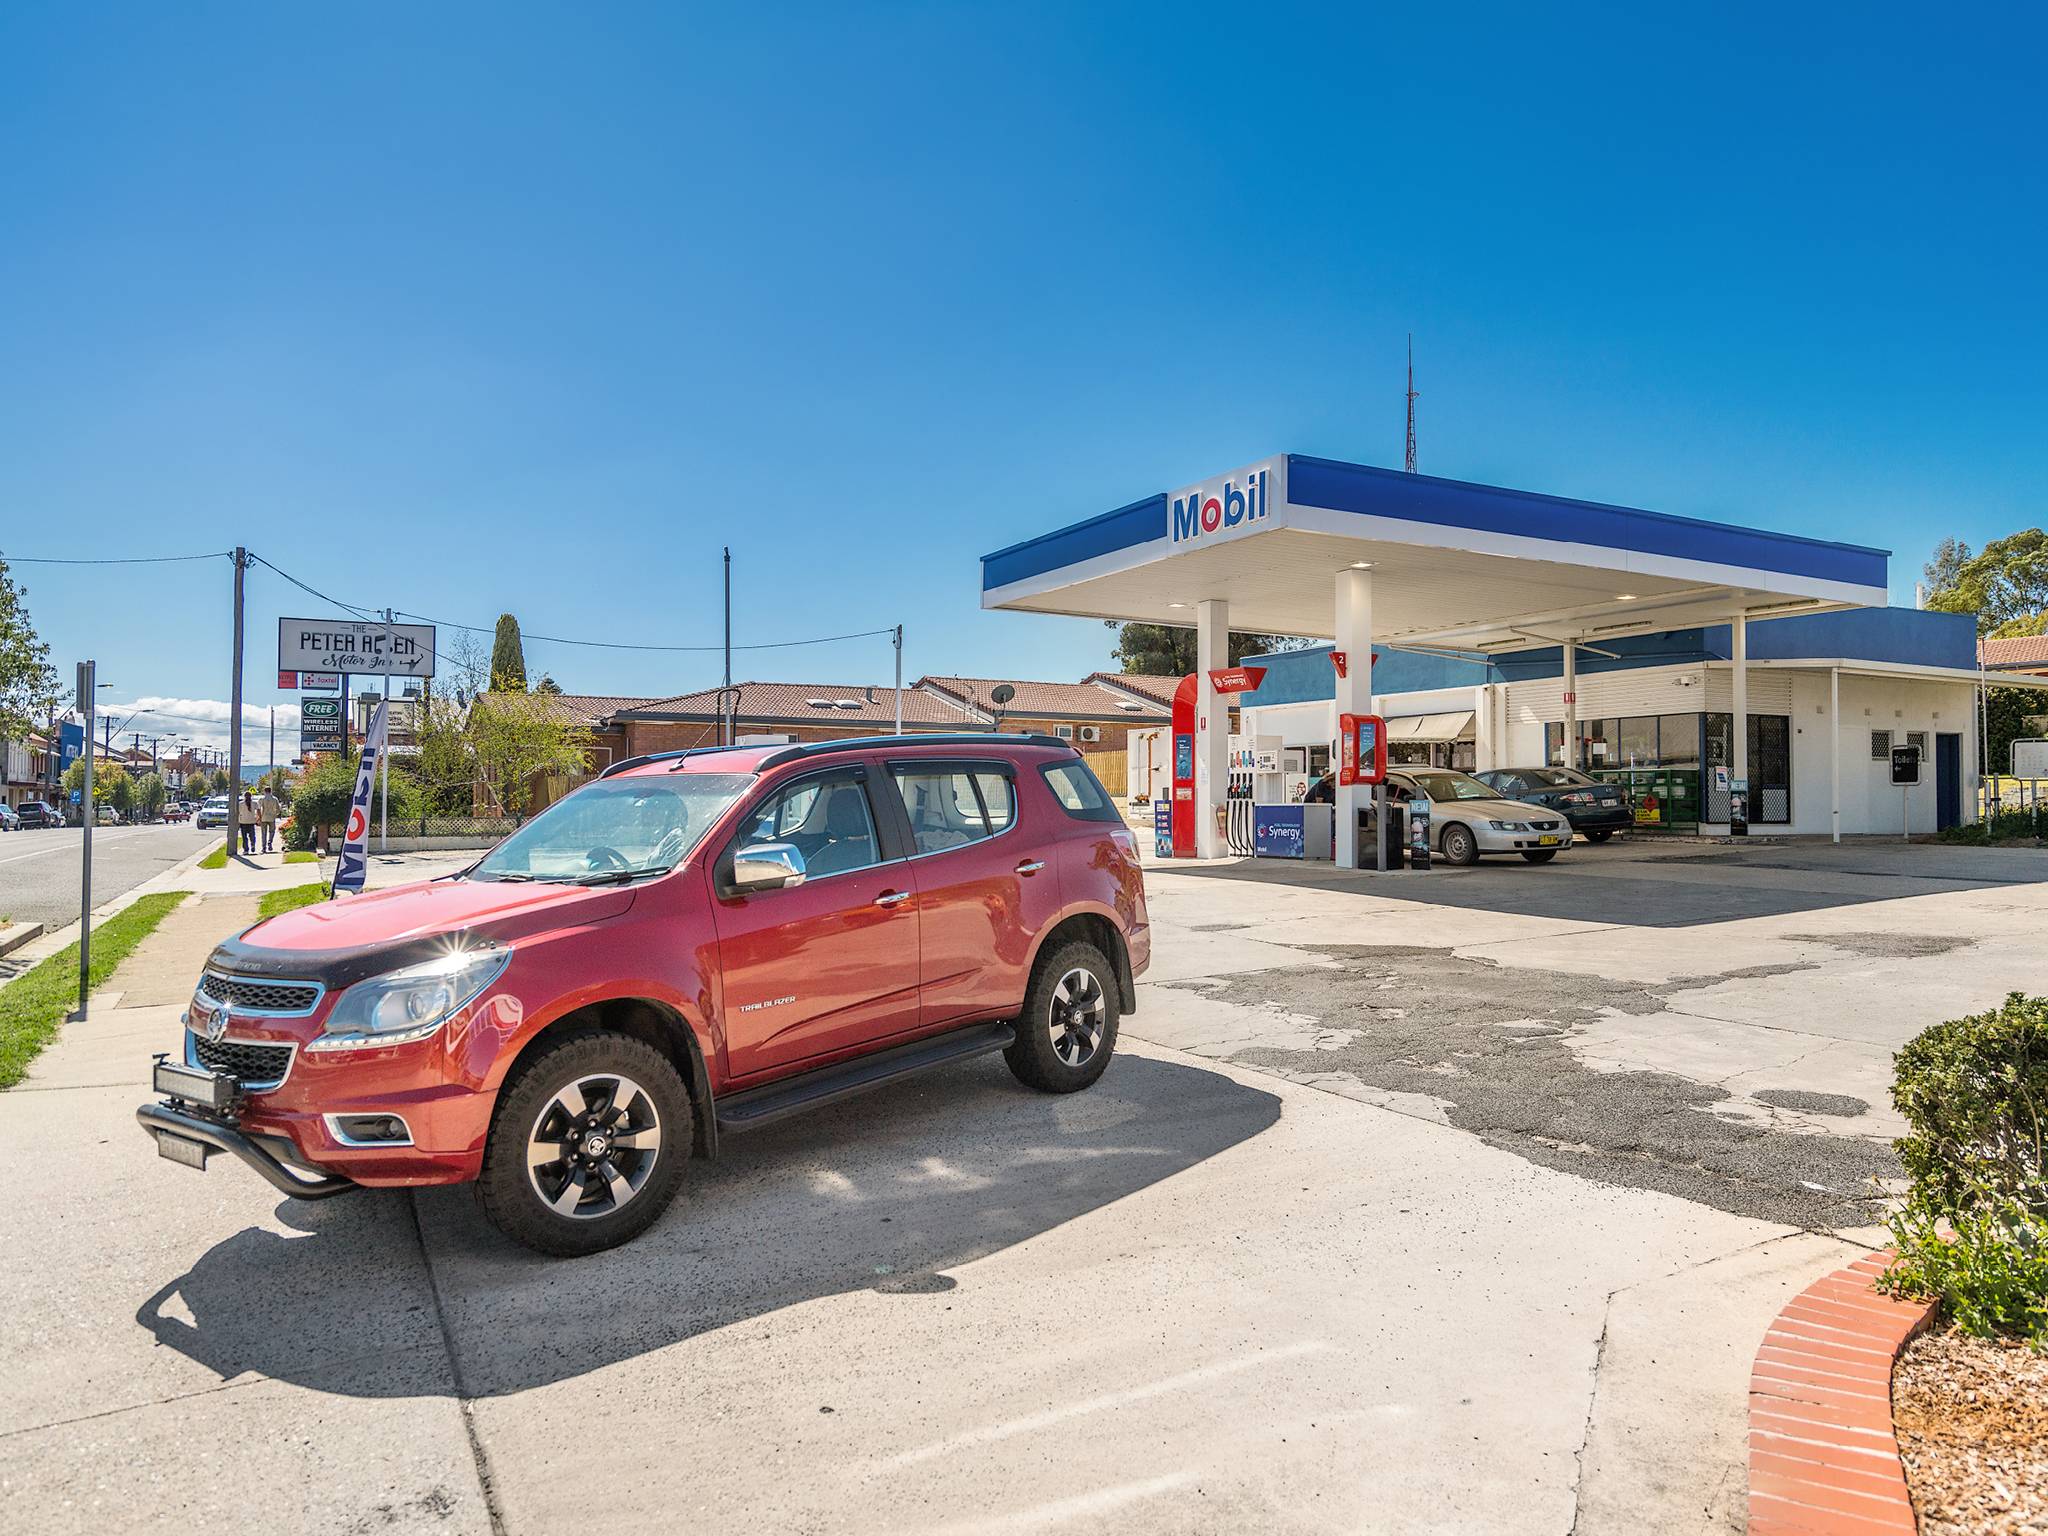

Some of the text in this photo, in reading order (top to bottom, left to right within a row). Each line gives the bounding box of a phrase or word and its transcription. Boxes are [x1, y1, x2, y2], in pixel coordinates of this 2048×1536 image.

[1173, 470, 1266, 543] Mobil
[352, 625, 366, 633] THE
[300, 631, 356, 653] PETER
[322, 654, 366, 670] Motor
[1338, 655, 1345, 664] 2
[308, 704, 333, 714] FREE
[303, 724, 338, 732] INTERNET
[1411, 802, 1429, 811] NEW
[1268, 825, 1300, 840] Synergy
[740, 995, 796, 1013] TRAILBLAZER
